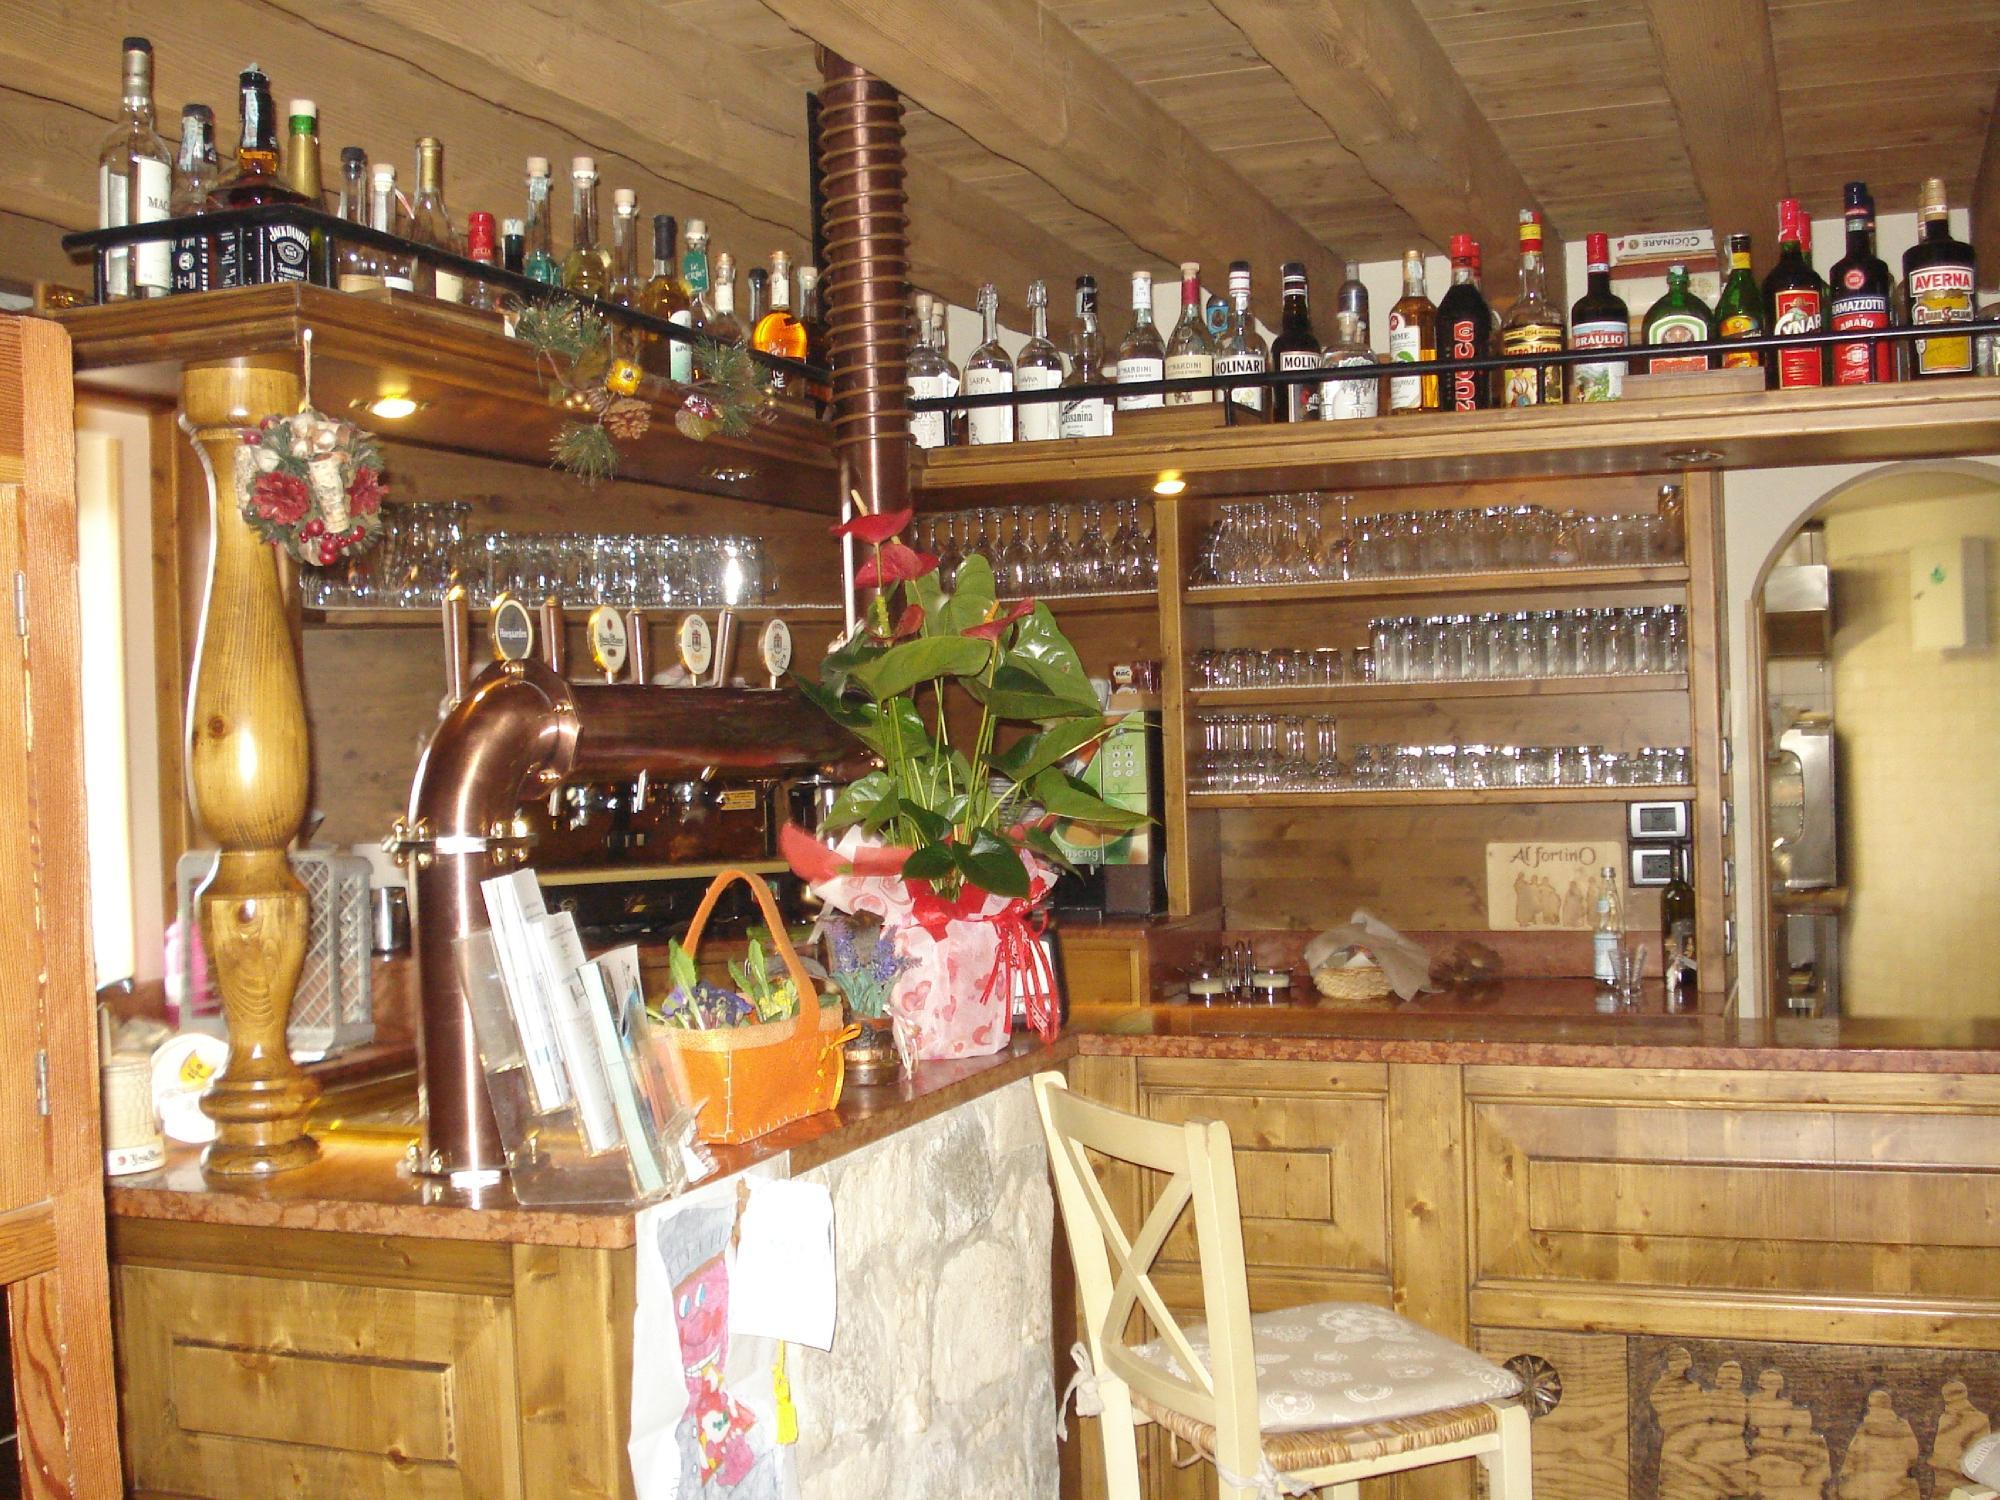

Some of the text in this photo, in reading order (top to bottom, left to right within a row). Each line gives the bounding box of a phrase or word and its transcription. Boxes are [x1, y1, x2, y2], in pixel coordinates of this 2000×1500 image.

[1915, 273, 1970, 289] AVERNA
[1840, 318, 1873, 331] AMARO
[1575, 334, 1623, 347] BRAULIO
[1284, 355, 1320, 370] MOLIN
[1510, 847, 1530, 864] Al
